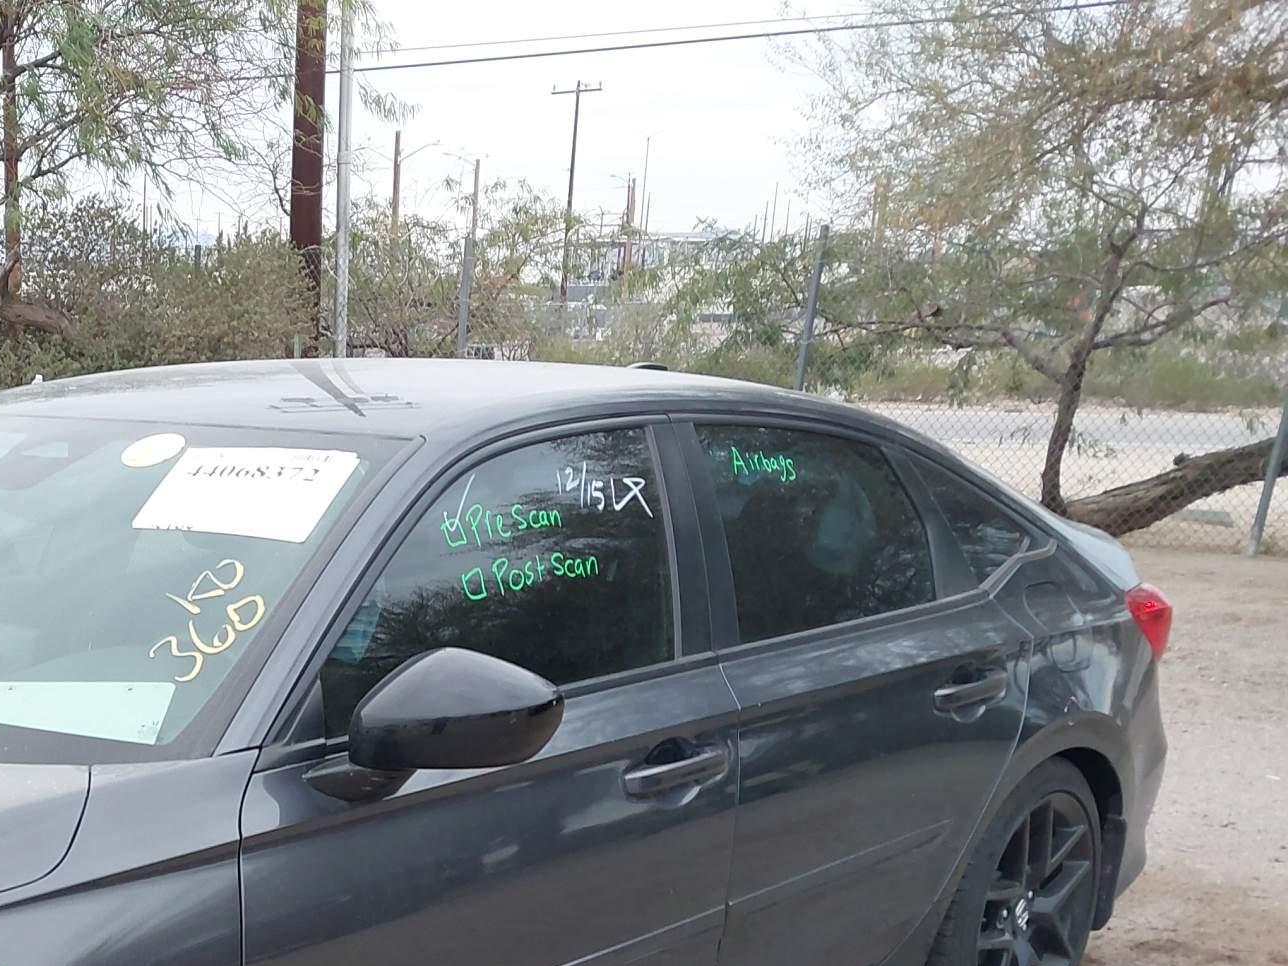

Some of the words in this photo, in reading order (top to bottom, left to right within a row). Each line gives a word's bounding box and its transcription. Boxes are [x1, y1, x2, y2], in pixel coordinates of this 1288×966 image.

[731, 446, 796, 482] Airbags
[491, 554, 544, 597] Post
[550, 552, 600, 578] Scan
[149, 594, 265, 682] 360
